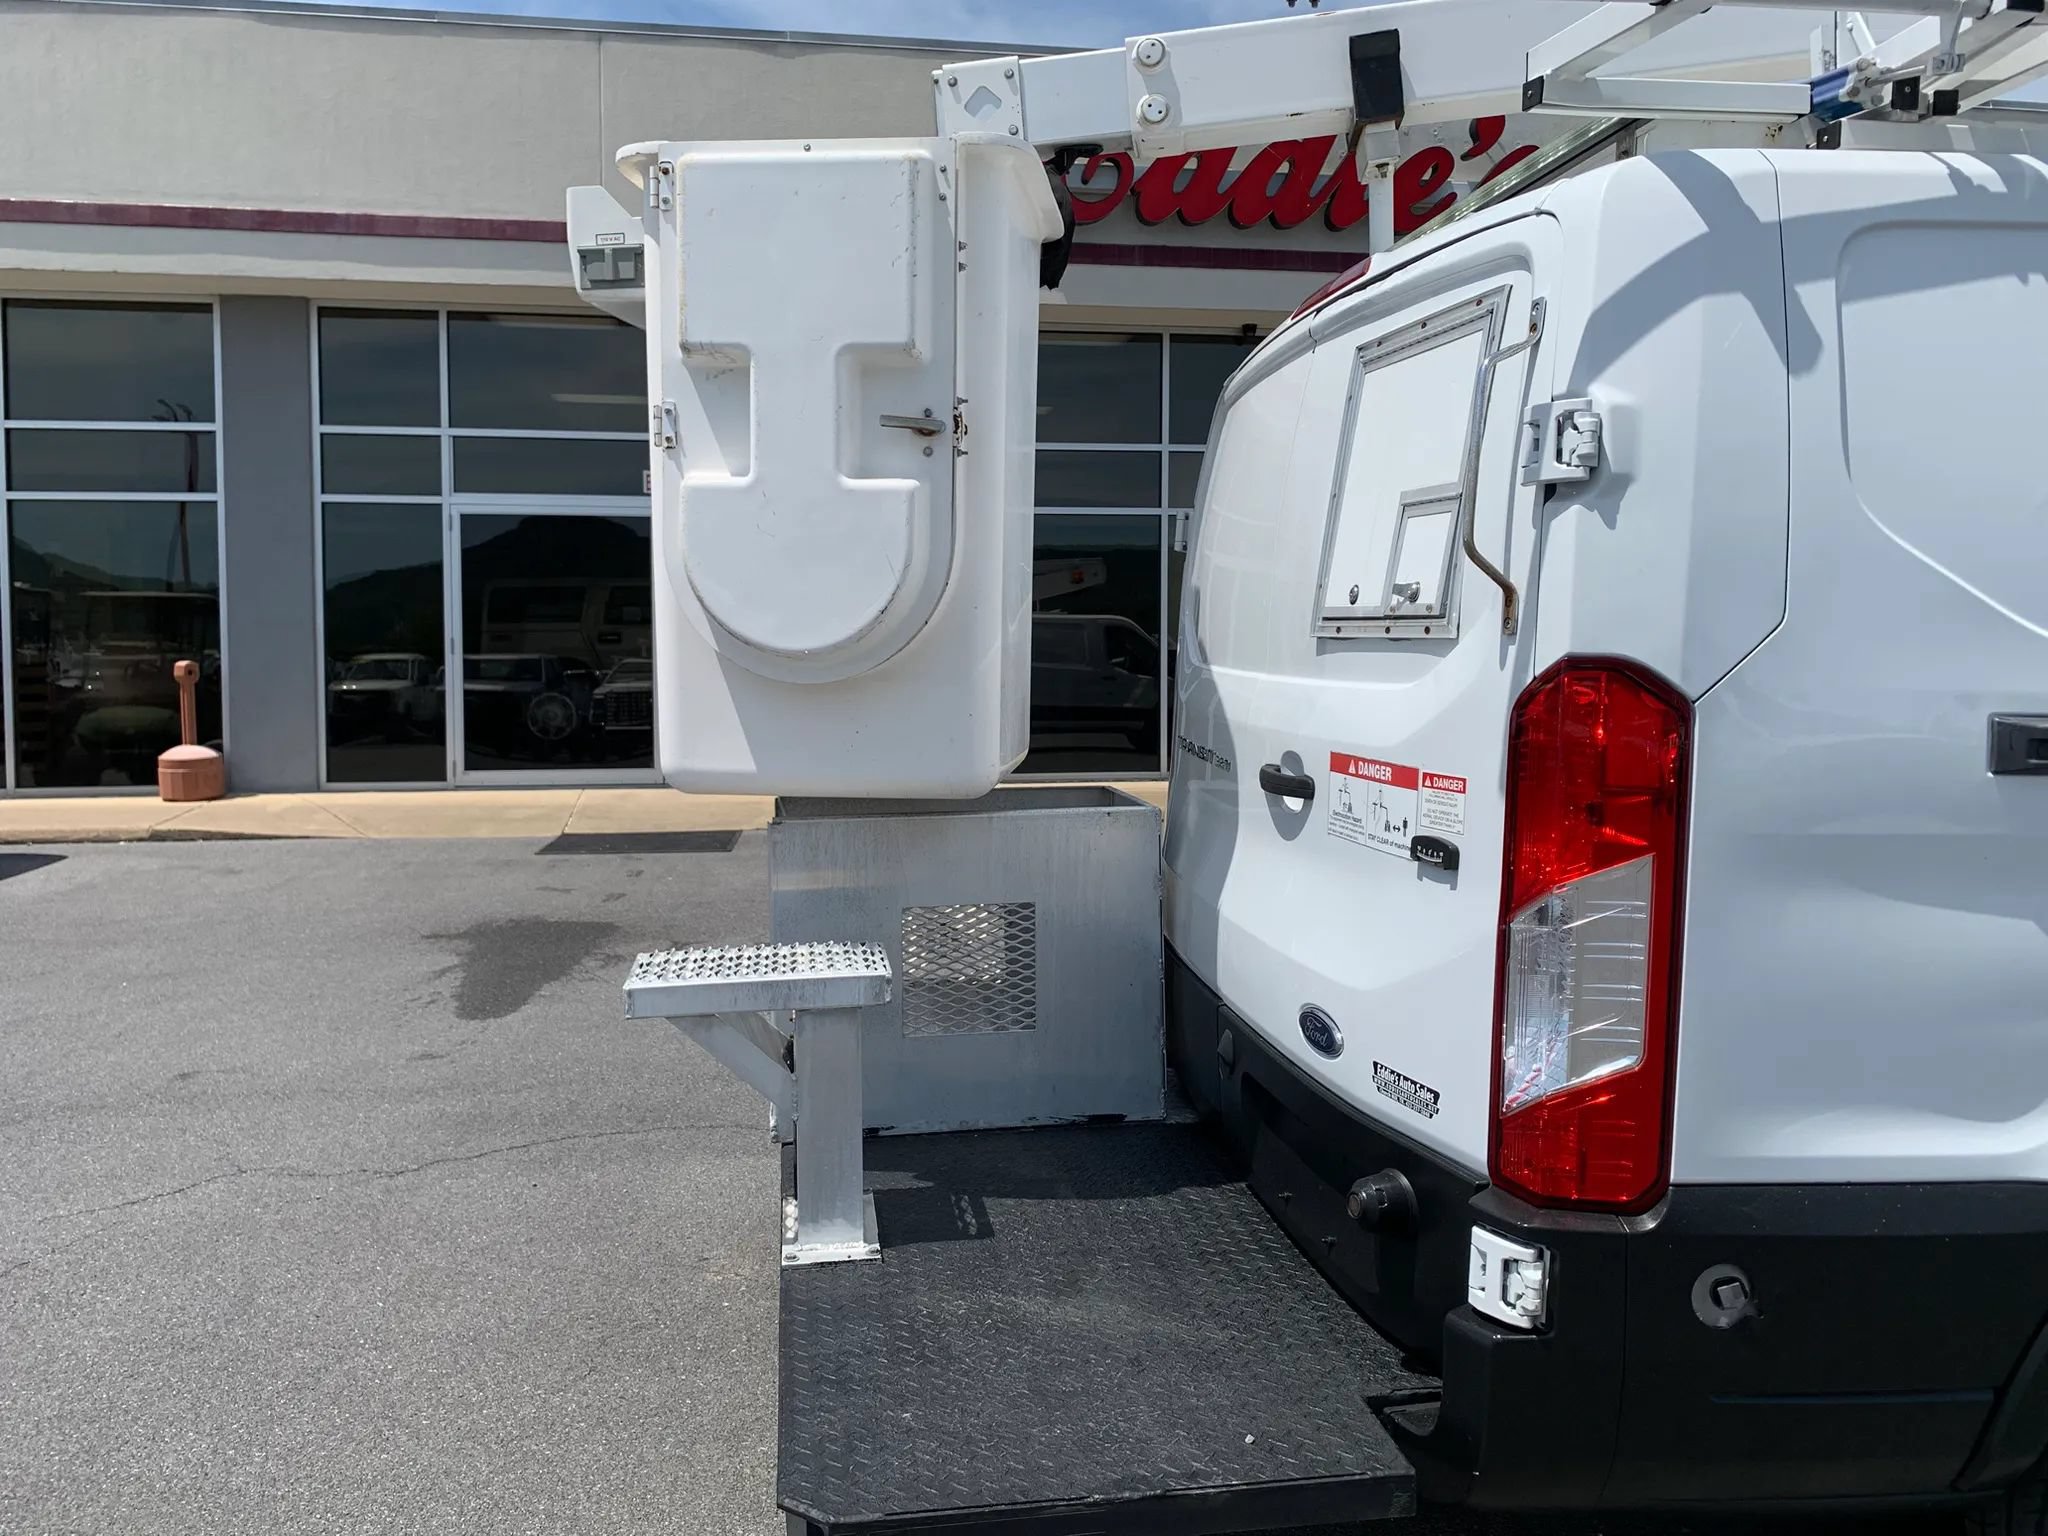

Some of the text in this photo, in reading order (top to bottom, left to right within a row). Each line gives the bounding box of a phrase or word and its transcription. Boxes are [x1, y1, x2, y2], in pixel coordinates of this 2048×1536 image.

[1358, 760, 1392, 782] DANGER
[1433, 776, 1464, 792] DANGER
[1304, 1016, 1328, 1047] Ford
[1376, 1063, 1399, 1086] Eddie's
[1399, 1075, 1416, 1094] Auto
[1415, 1083, 1435, 1104] Sales
